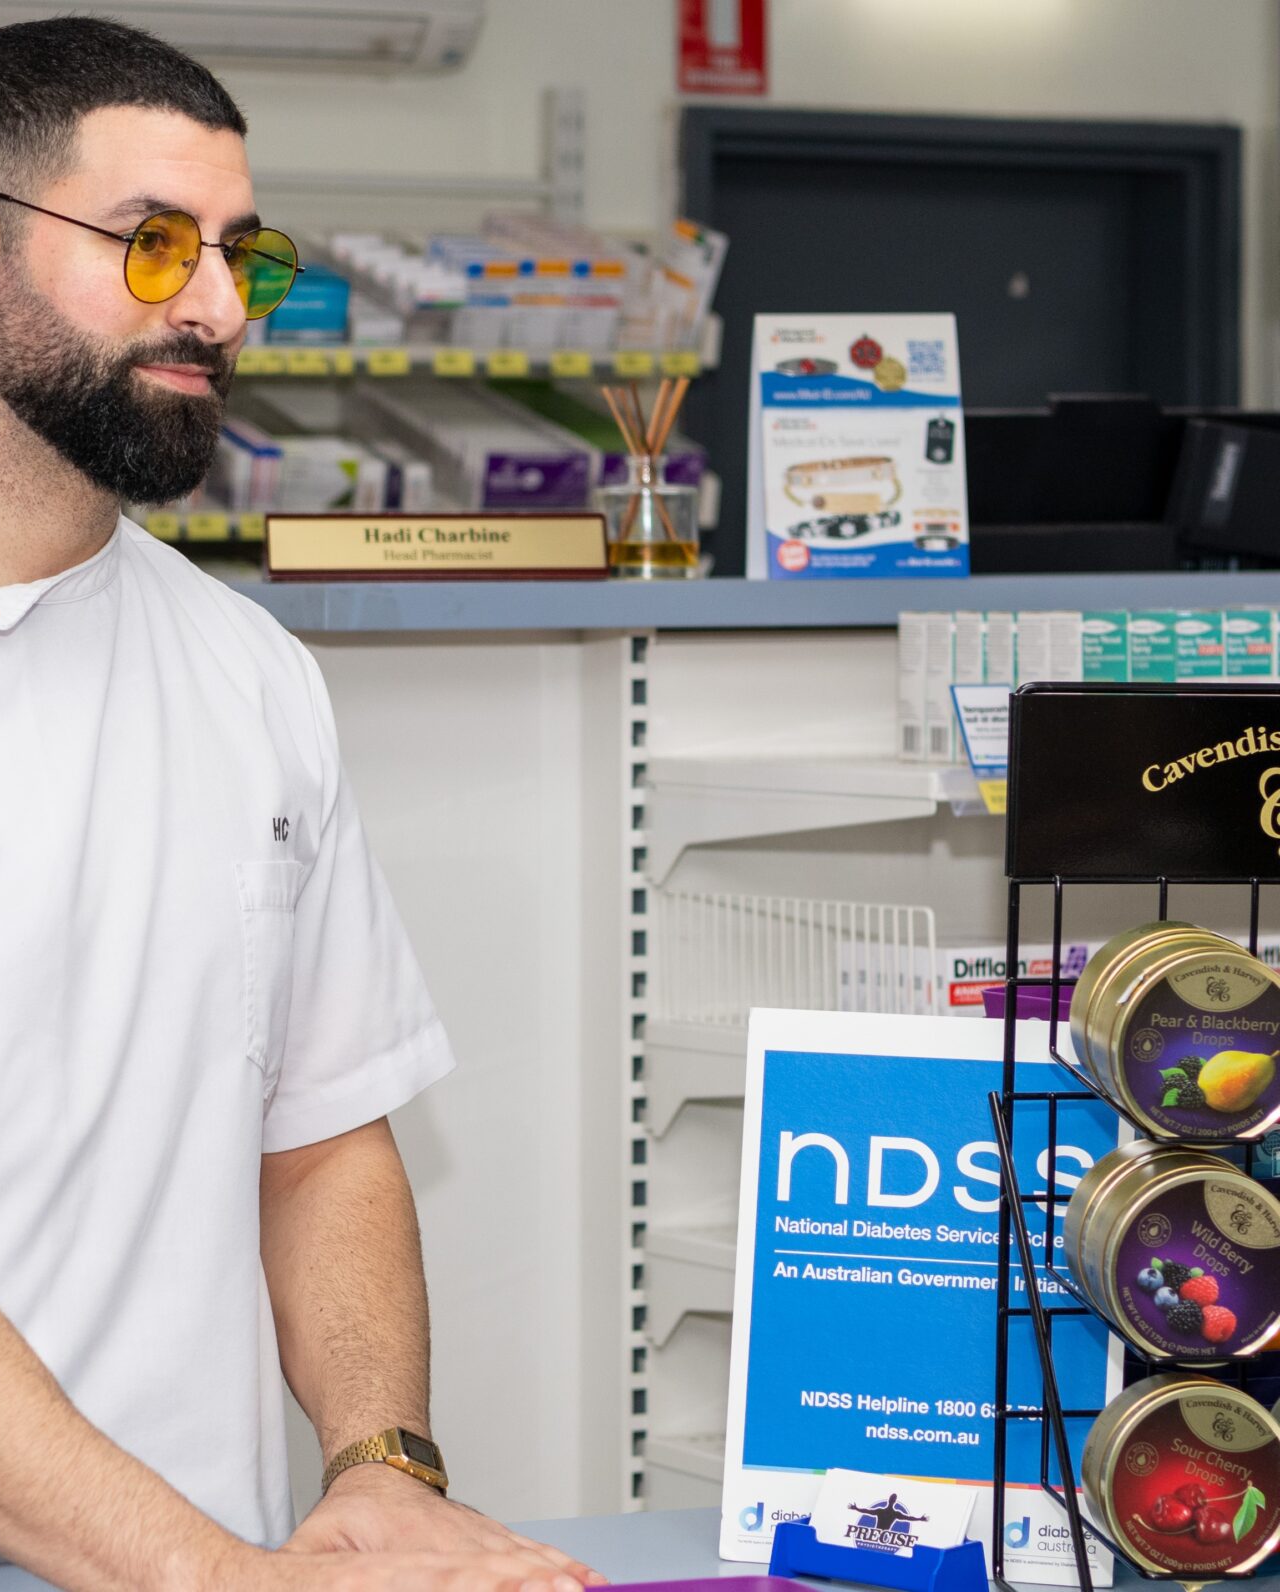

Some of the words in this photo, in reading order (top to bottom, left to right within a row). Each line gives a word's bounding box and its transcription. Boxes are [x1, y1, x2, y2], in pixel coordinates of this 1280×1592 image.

[365, 528, 412, 543] Hadi
[418, 527, 511, 544] Charbine
[384, 550, 417, 561] Head
[422, 549, 494, 561] Pharmacist
[272, 817, 289, 842] HC
[1174, 965, 1221, 983] Cavendish
[1223, 965, 1231, 973] &
[1234, 967, 1262, 986] Harvey
[1151, 1013, 1184, 1028] Pear
[1186, 1015, 1198, 1028] &
[1202, 1015, 1279, 1036] Blackberry
[1192, 1031, 1235, 1048] Drops
[1211, 1185, 1255, 1205] Cavendish
[775, 1216, 848, 1236] National
[853, 1220, 931, 1241] Diabetes
[1191, 1220, 1221, 1249] Wild
[1218, 1241, 1254, 1275] Berry
[1192, 1243, 1231, 1277] Drops
[773, 1261, 798, 1278] An
[802, 1263, 892, 1284] Australian
[897, 1268, 999, 1290] Governmen
[801, 1391, 852, 1408] NDSS
[857, 1394, 929, 1414] Helpline
[934, 1400, 976, 1417] 1800
[1186, 1400, 1232, 1411] Cavendish
[1234, 1407, 1242, 1415] &
[1242, 1411, 1267, 1437] Harvey
[865, 1424, 980, 1445] ndss.com.au
[1171, 1438, 1205, 1460] Sour
[1206, 1451, 1253, 1481] Cherry
[1184, 1461, 1226, 1487] Drops
[845, 1524, 919, 1549] PRECISE
[1038, 1525, 1097, 1541] diabe
[1037, 1541, 1097, 1555] austra
[1193, 1561, 1217, 1571] POIDS
